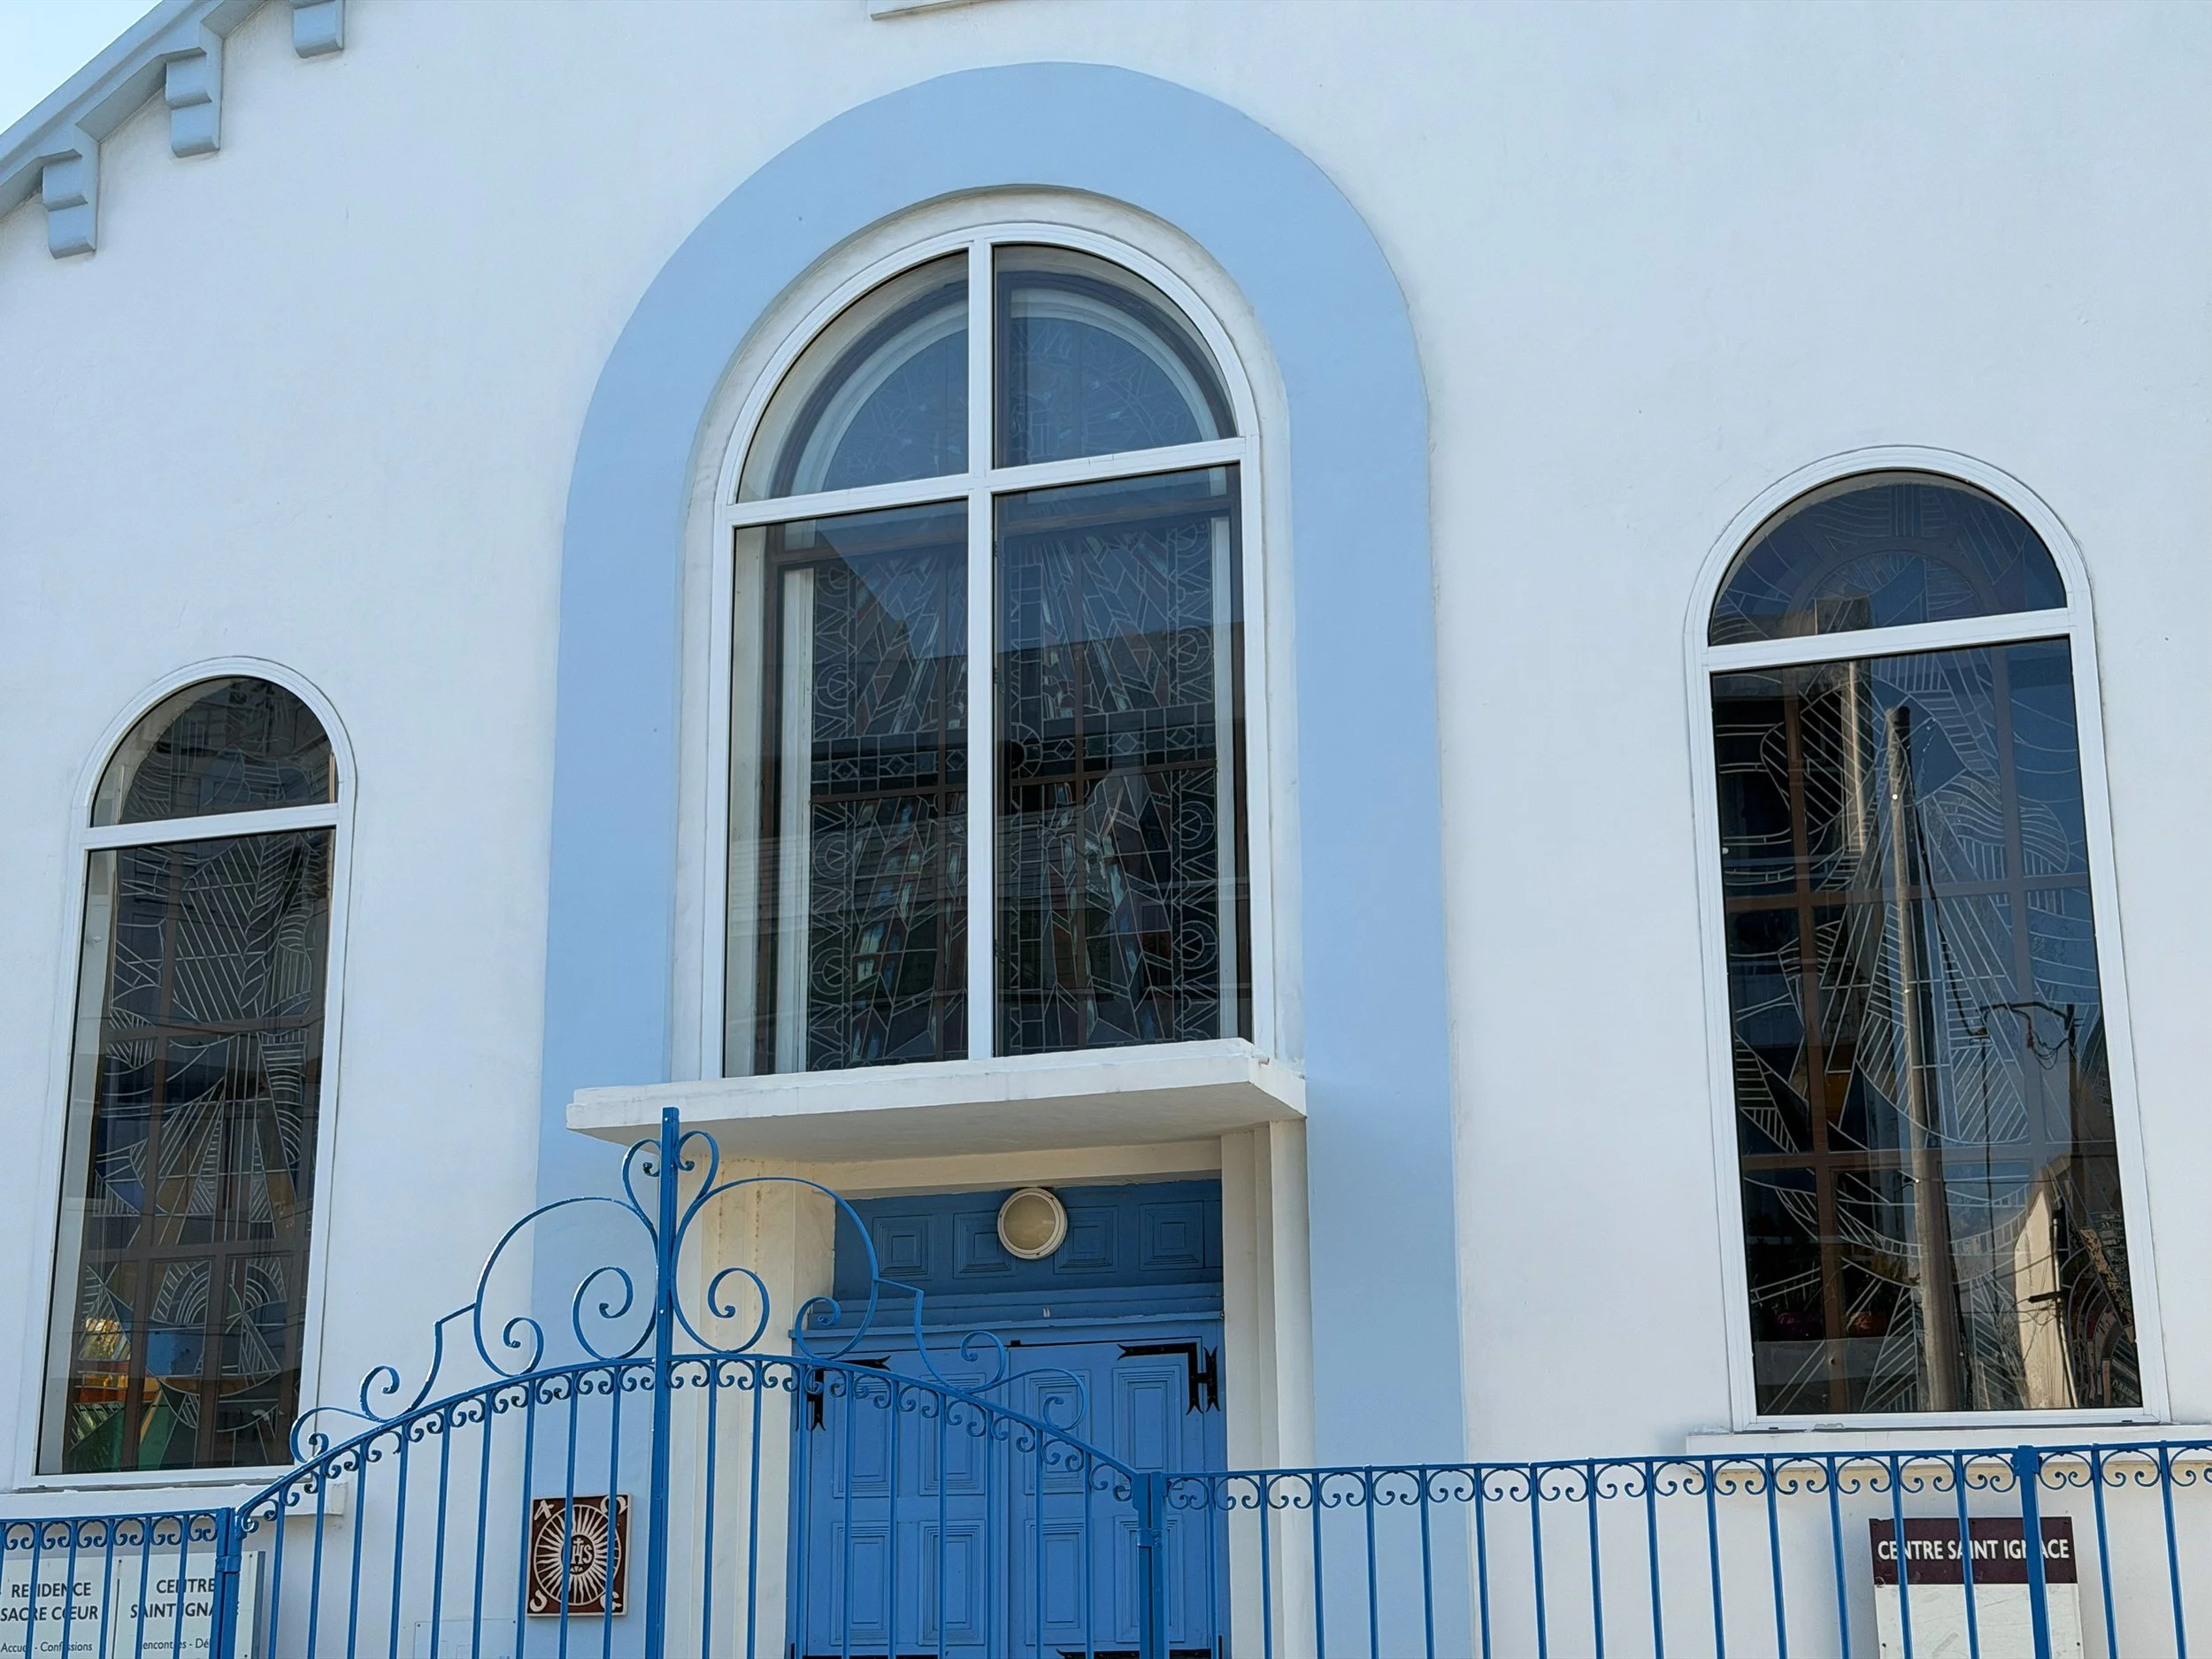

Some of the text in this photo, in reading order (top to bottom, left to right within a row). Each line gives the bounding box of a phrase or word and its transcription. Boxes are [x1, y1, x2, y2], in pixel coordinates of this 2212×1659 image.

[1878, 1540, 1944, 1560] CENTRE
[1947, 1540, 1999, 1560] SAINT
[12, 1582, 92, 1598] REIDENCE
[156, 1578, 215, 1594] CENTRE
[40, 1641, 93, 1652] Confssions
